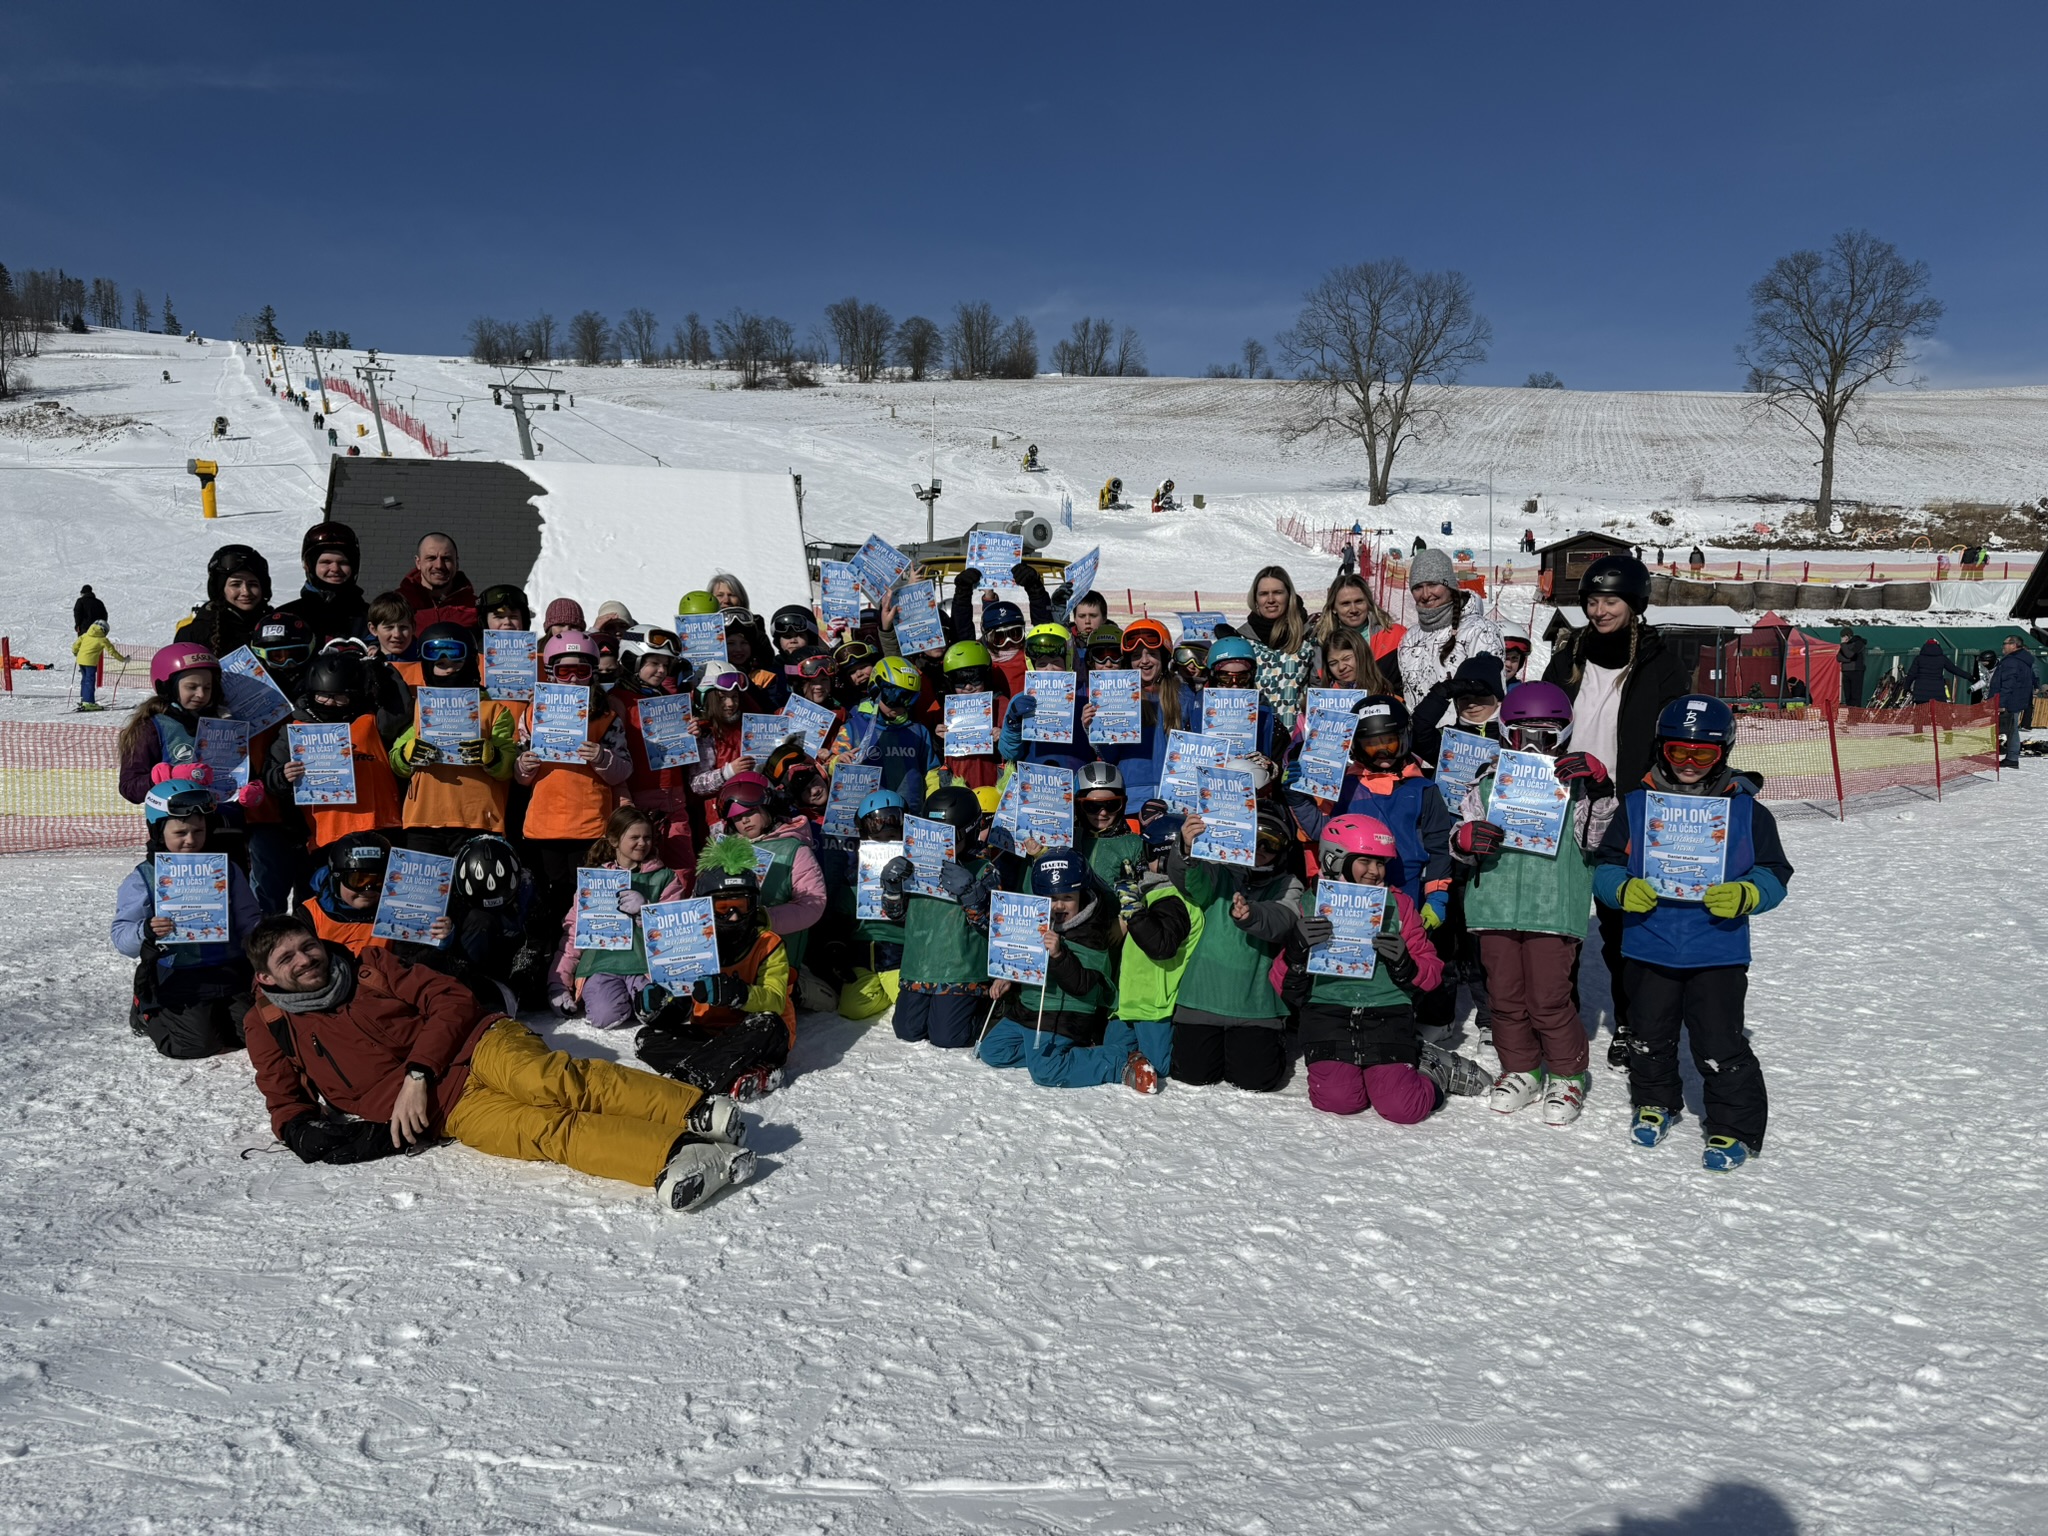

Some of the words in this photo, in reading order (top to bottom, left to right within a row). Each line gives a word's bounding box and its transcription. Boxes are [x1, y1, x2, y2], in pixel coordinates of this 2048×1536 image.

[985, 537, 1012, 547] DIPLOM
[875, 543, 900, 564] DIPLOM
[898, 589, 925, 605] DIPLOM
[266, 626, 283, 635] TEO
[685, 621, 714, 633] DIPLOM
[495, 638, 526, 649] DIPLOM
[1035, 679, 1065, 689] DIPLOM
[1099, 678, 1129, 689] DIPLOM
[430, 697, 466, 708] DIPLOM
[545, 692, 577, 706] DIPLOM
[954, 698, 981, 708] DIPLOM
[1214, 697, 1247, 709] DIPLOM
[1319, 697, 1353, 708] DIPLOM
[649, 702, 680, 716] DIPLOM
[794, 704, 823, 725] DIPLOM
[752, 722, 780, 734] DIPLOM
[1317, 719, 1346, 735] DIPLOM
[206, 728, 236, 742] DIPLOM
[302, 733, 337, 745] DIPLOM
[316, 744, 332, 752] ÚČAST
[885, 746, 916, 757] JAKO
[1179, 741, 1215, 759] DIPLOM
[1453, 740, 1489, 761] DIPLOM
[1183, 755, 1190, 763] ZA
[1457, 755, 1464, 763] ZA
[842, 772, 871, 785] DIPLOM
[1029, 772, 1061, 788] DIPLOM
[1516, 778, 1525, 787] ZA
[1526, 777, 1547, 790] ÚČAST
[1208, 777, 1242, 794] DIPLOM
[1213, 792, 1219, 800] ZA
[1661, 805, 1710, 825] DIPLOM
[1668, 823, 1677, 833] ZA
[1678, 821, 1701, 834] ÚČAST
[913, 826, 943, 844] DIPLOM
[354, 849, 380, 857] ALEX
[169, 864, 212, 877] DIPLOM
[400, 860, 440, 879] DIPLOM
[176, 878, 184, 886] ZA
[185, 876, 205, 885] ÚČAST
[404, 875, 413, 884] ZA
[413, 874, 432, 886] ÚČAST
[589, 877, 618, 890] DIPLOM
[1330, 892, 1371, 910] DIPLOM
[1002, 902, 1037, 919] DIPLOM
[1335, 908, 1343, 917] ZA
[1343, 907, 1363, 918] ÚČAST
[656, 909, 699, 929] DIPLOM
[1007, 917, 1014, 925] ZA
[1014, 916, 1031, 927] ÚČAST
[665, 929, 673, 938] ZA
[673, 924, 693, 936] ÚČAST
